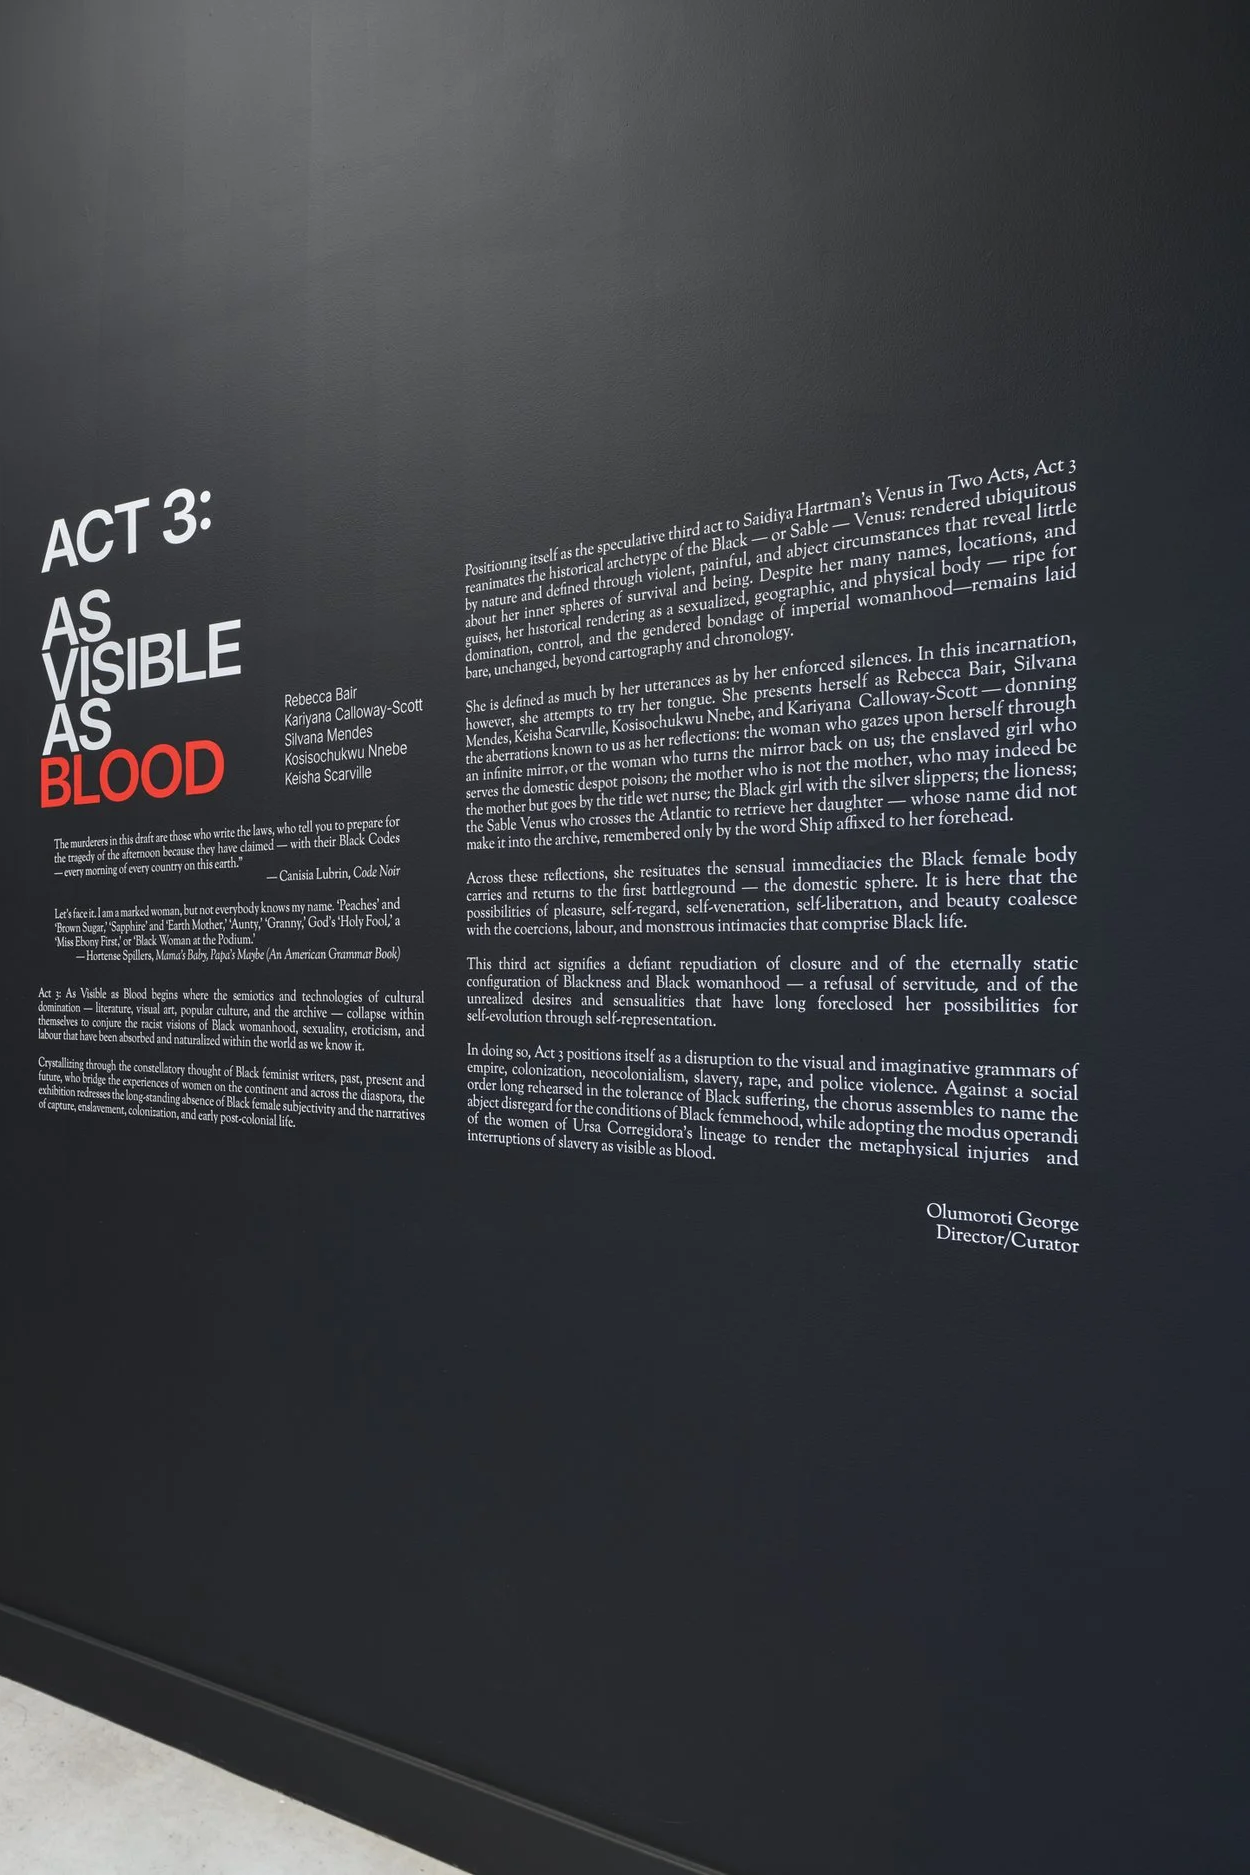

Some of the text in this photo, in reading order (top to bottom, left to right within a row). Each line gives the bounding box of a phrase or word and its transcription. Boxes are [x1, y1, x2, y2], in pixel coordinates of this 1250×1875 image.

[41, 487, 212, 573] ACT 3:
[465, 557, 527, 576] Positioning
[529, 546, 559, 565] itself
[560, 549, 572, 560] as
[575, 542, 594, 557] the
[597, 532, 665, 555] speculative
[668, 520, 700, 540] third
[703, 521, 723, 534] act
[725, 519, 740, 530] to
[743, 507, 793, 527] Saidiya
[875, 485, 924, 503] Venus
[928, 480, 943, 494] in
[947, 473, 983, 490] Two
[986, 467, 1029, 484] Acts,
[1033, 458, 1064, 476] Act
[1068, 459, 1076, 474] 3
[465, 517, 1076, 628] about her inner spheres of survival and being. Despite her many names, locations, and
[41, 588, 112, 650] AS
[42, 619, 242, 701] VISIBLE
[465, 633, 1076, 713] She is defined as much by her utterances as by her enforced silences. In this incarnation,
[284, 685, 357, 707] Rebecca Bair
[42, 698, 113, 756] AS
[284, 698, 423, 728] Kariyana Calloway-Scott
[284, 725, 373, 746] Silvana Mendes
[284, 741, 407, 766] Kosisochukwu Nnebe
[40, 739, 225, 809] BLOOD
[284, 765, 372, 785] Keisha Scarville
[53, 814, 400, 849] The murderers in this draft are those who write the laws, who tell you to prepare for
[466, 844, 1077, 884] Across these reflections, she resituates the sensual immediacies the Black female body
[466, 953, 1078, 973] This third act signifies a defiant repudiation of closure and of the eternally static
[37, 986, 425, 1005] Act 3: As Visible as Blood begins where the semiotics and technologies of cultural
[466, 990, 1078, 1015] unrealized desires and sensualities that have long foreclosed her possibilities for
[37, 1055, 425, 1087] Crystallizing through the constellatory thought of Black feminist writers, past, present and
[466, 1061, 1079, 1100] empire, colonization, neocolonialism, slavery, rape, and police violence. Against a social
[926, 1202, 1079, 1234] Olumoroti George
[936, 1223, 1080, 1253] Director/Curator
